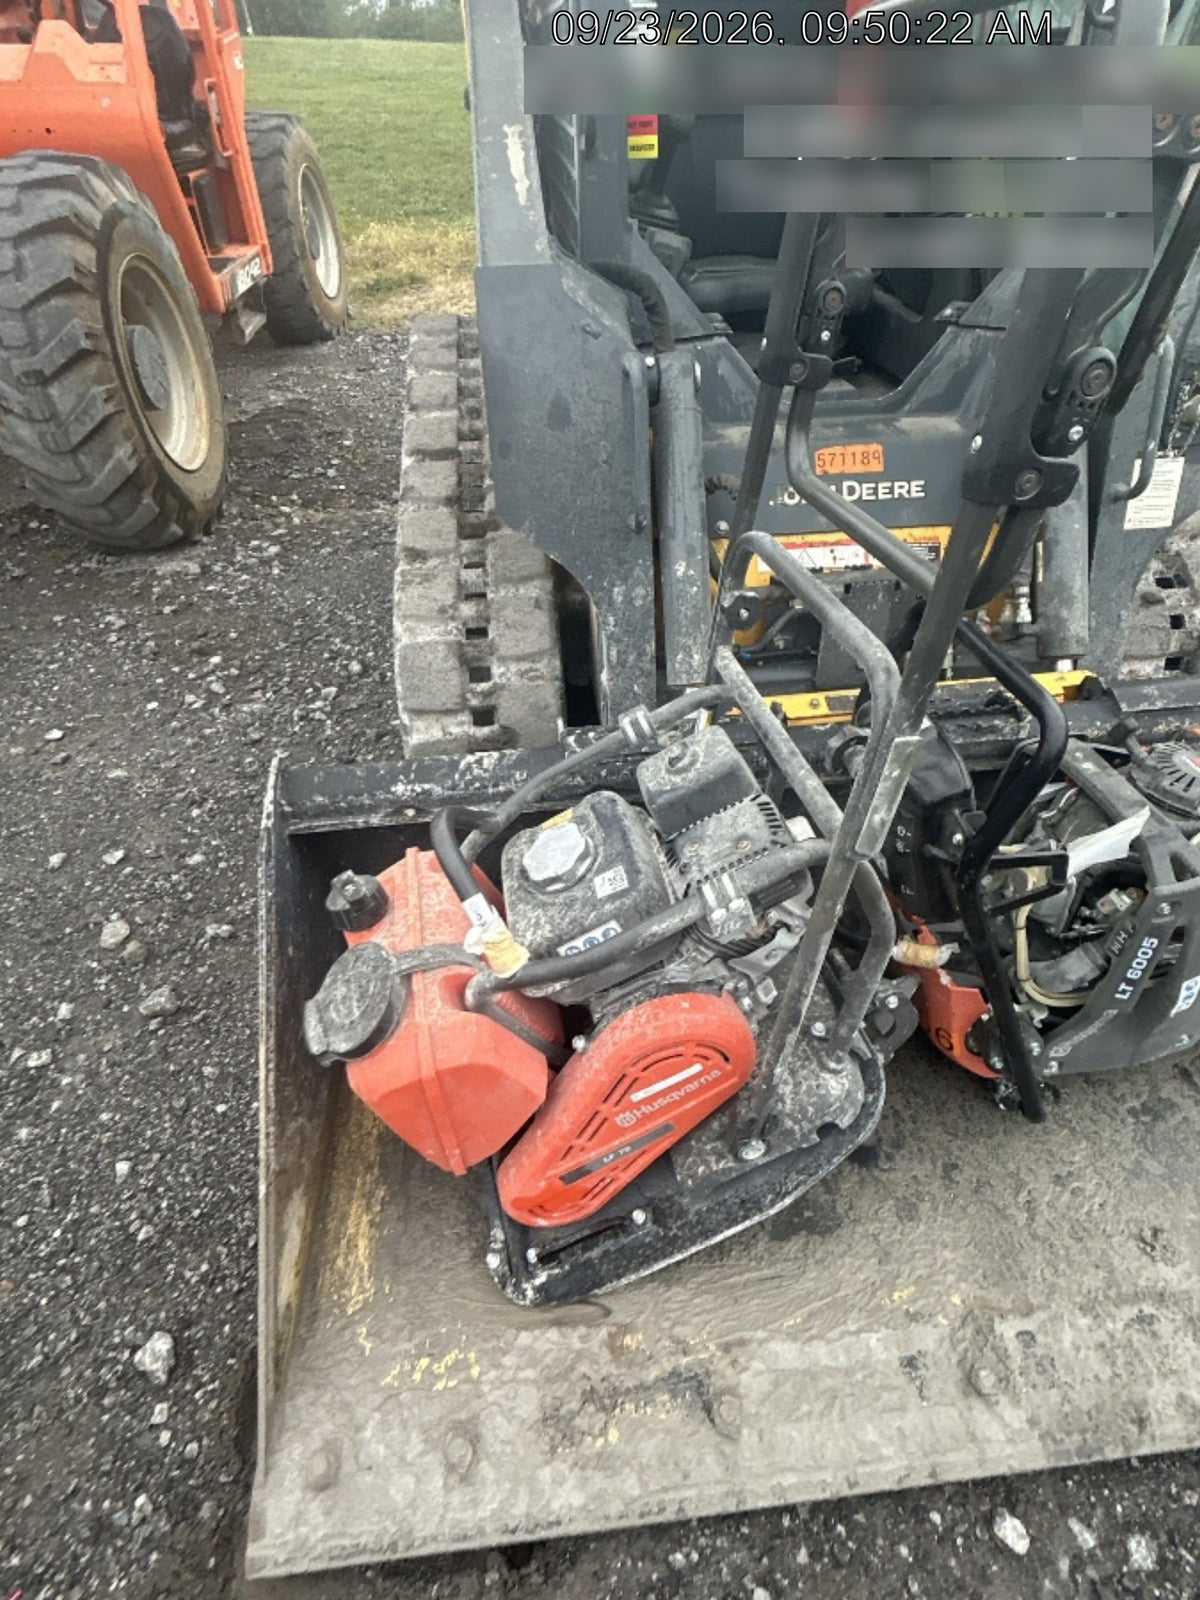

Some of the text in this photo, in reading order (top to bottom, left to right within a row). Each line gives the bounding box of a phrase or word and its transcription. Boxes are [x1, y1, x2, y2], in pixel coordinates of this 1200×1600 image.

[842, 480, 925, 501] DEERE
[1114, 982, 1134, 1000] LT
[1126, 937, 1159, 980] 6005
